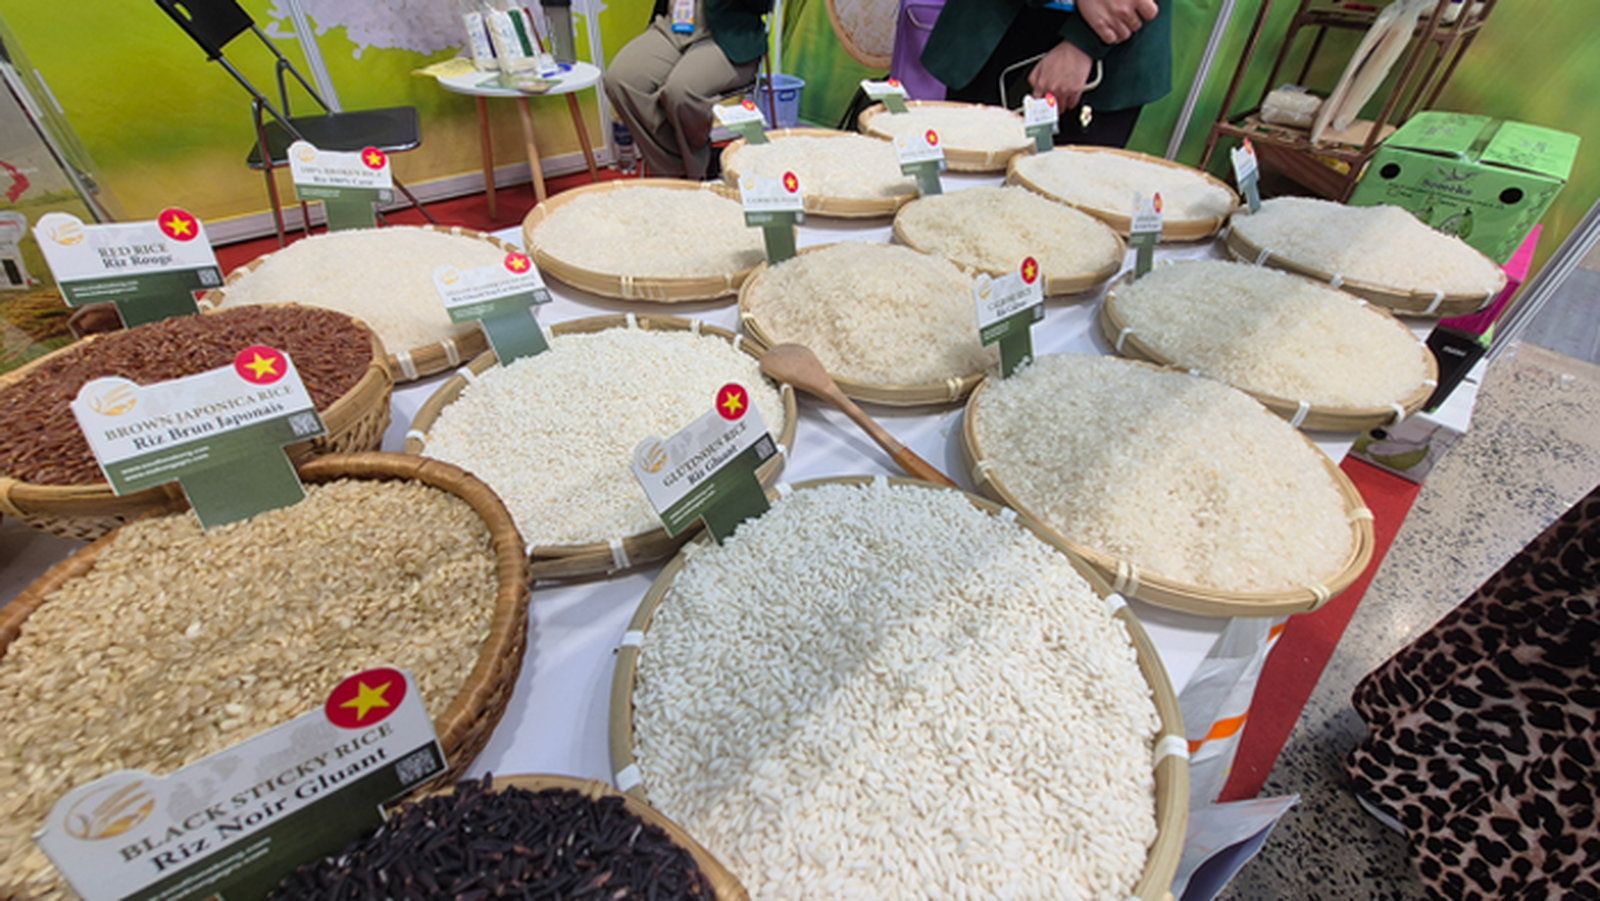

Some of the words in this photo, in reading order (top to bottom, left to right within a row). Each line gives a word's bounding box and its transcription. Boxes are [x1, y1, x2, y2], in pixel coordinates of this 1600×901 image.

[98, 247, 131, 257] RED
[134, 244, 167, 255] RICE
[102, 258, 127, 269] Riz
[132, 255, 173, 267] Rouge
[104, 418, 173, 442] BROWN
[176, 395, 256, 424] JAPONICA
[259, 384, 294, 400] RICE
[132, 434, 165, 450] Riz
[169, 421, 214, 441] Brun
[217, 403, 284, 429] Japonais
[663, 439, 723, 487] GLUTINOUS
[722, 421, 746, 443] RICE
[687, 470, 705, 485] Riz
[705, 445, 738, 472] Gluant
[119, 801, 227, 863] BLACK
[231, 750, 331, 809] STICKY
[333, 722, 393, 759] RICE
[150, 838, 210, 872] Riz
[214, 795, 288, 840] Noir
[294, 747, 388, 802] Gluant
